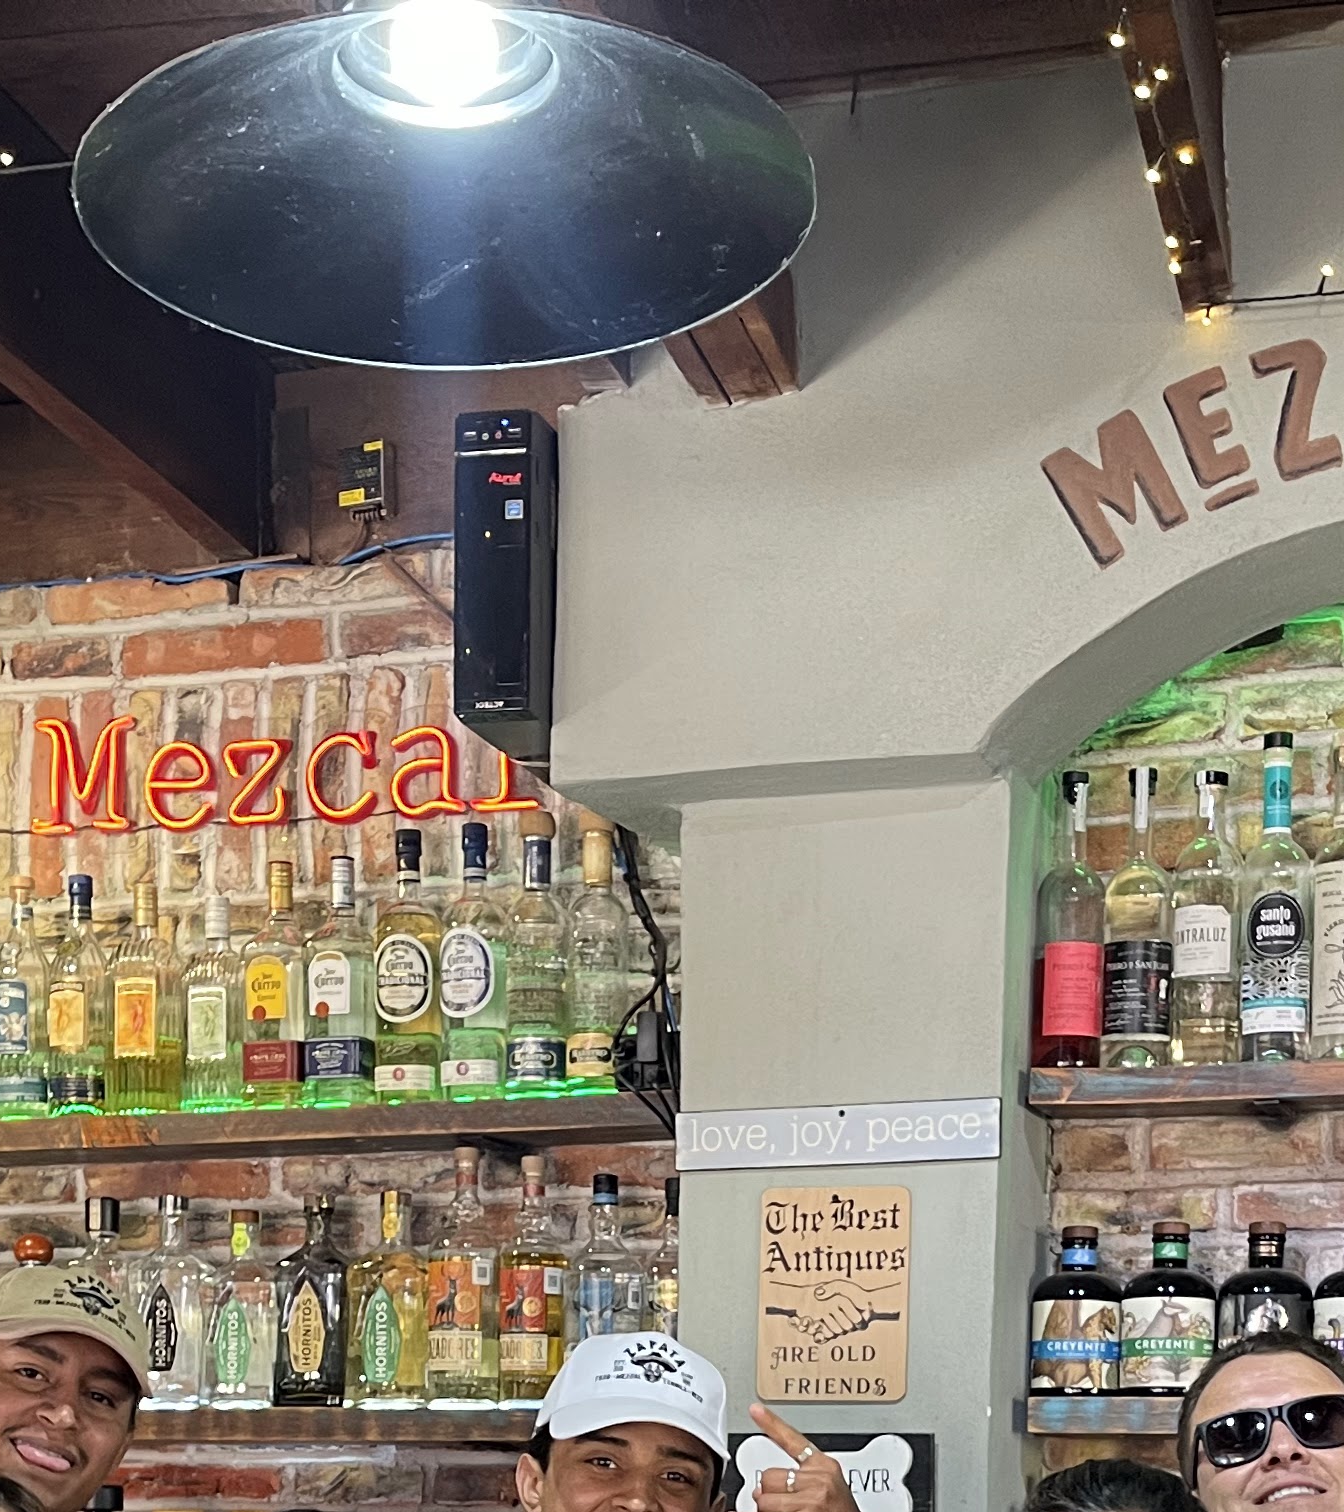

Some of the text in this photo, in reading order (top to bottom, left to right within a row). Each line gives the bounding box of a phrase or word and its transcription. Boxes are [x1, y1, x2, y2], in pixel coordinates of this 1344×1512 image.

[30, 714, 540, 836] Mezcal
[690, 1108, 991, 1158] love, joy, peace.
[765, 1199, 901, 1240] The Best
[763, 1242, 907, 1278] Antiques
[155, 1298, 167, 1367] HORNITOS
[227, 1311, 239, 1380] HORNITOS
[301, 1297, 313, 1367] HORNITOS
[375, 1301, 387, 1379] HORNITOS
[1047, 1341, 1107, 1352] CREYENTE
[1135, 1339, 1196, 1351] CREYENTE
[623, 1340, 686, 1368] ZAPATA
[770, 1344, 876, 1371] ARE OLD
[784, 1376, 888, 1396] FRIENDS
